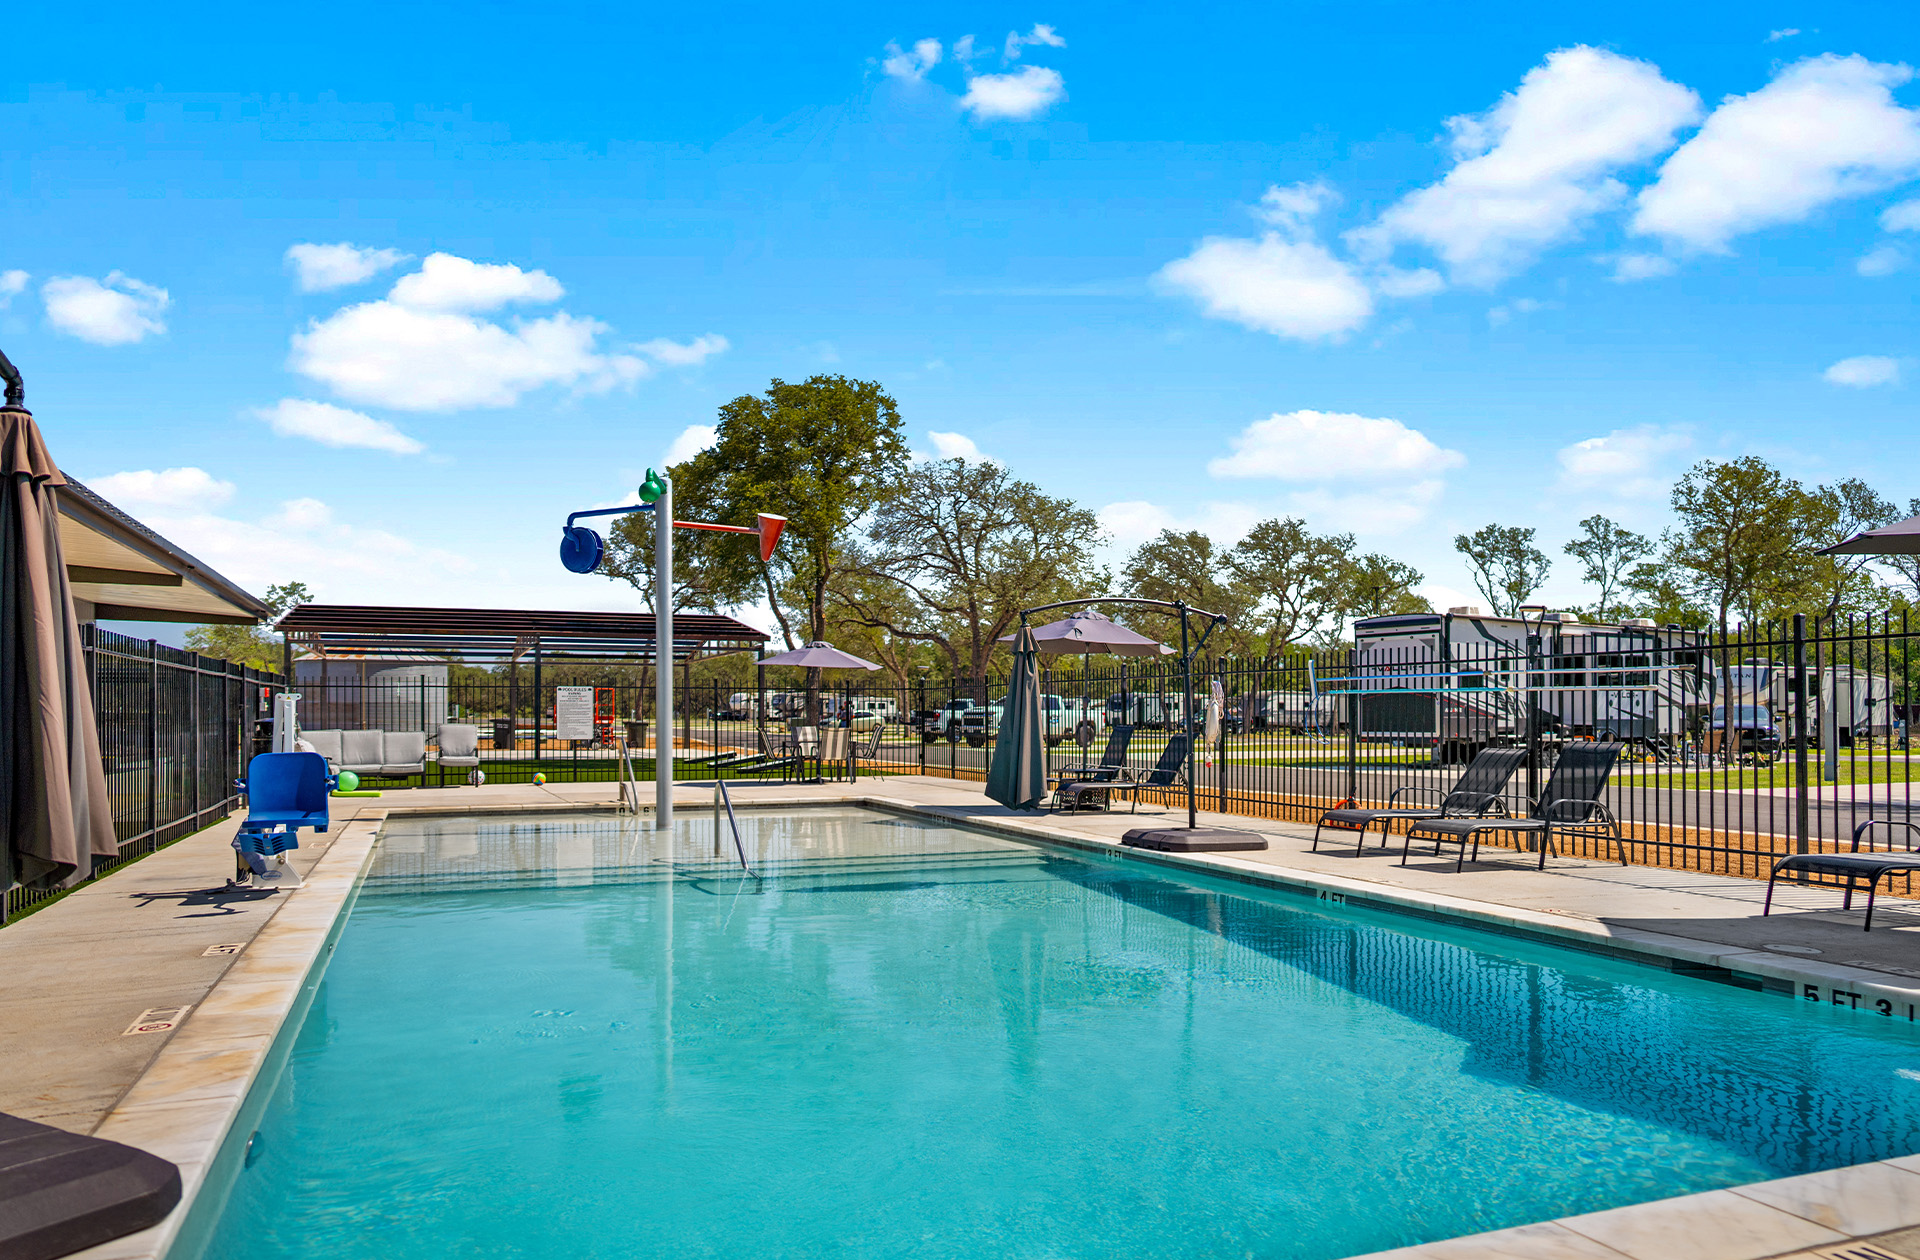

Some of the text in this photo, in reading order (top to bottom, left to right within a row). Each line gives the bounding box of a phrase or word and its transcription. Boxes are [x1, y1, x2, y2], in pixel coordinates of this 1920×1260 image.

[1331, 892, 1345, 904] FT
[1804, 984, 1819, 1002] 5
[1832, 989, 1862, 1010] FT
